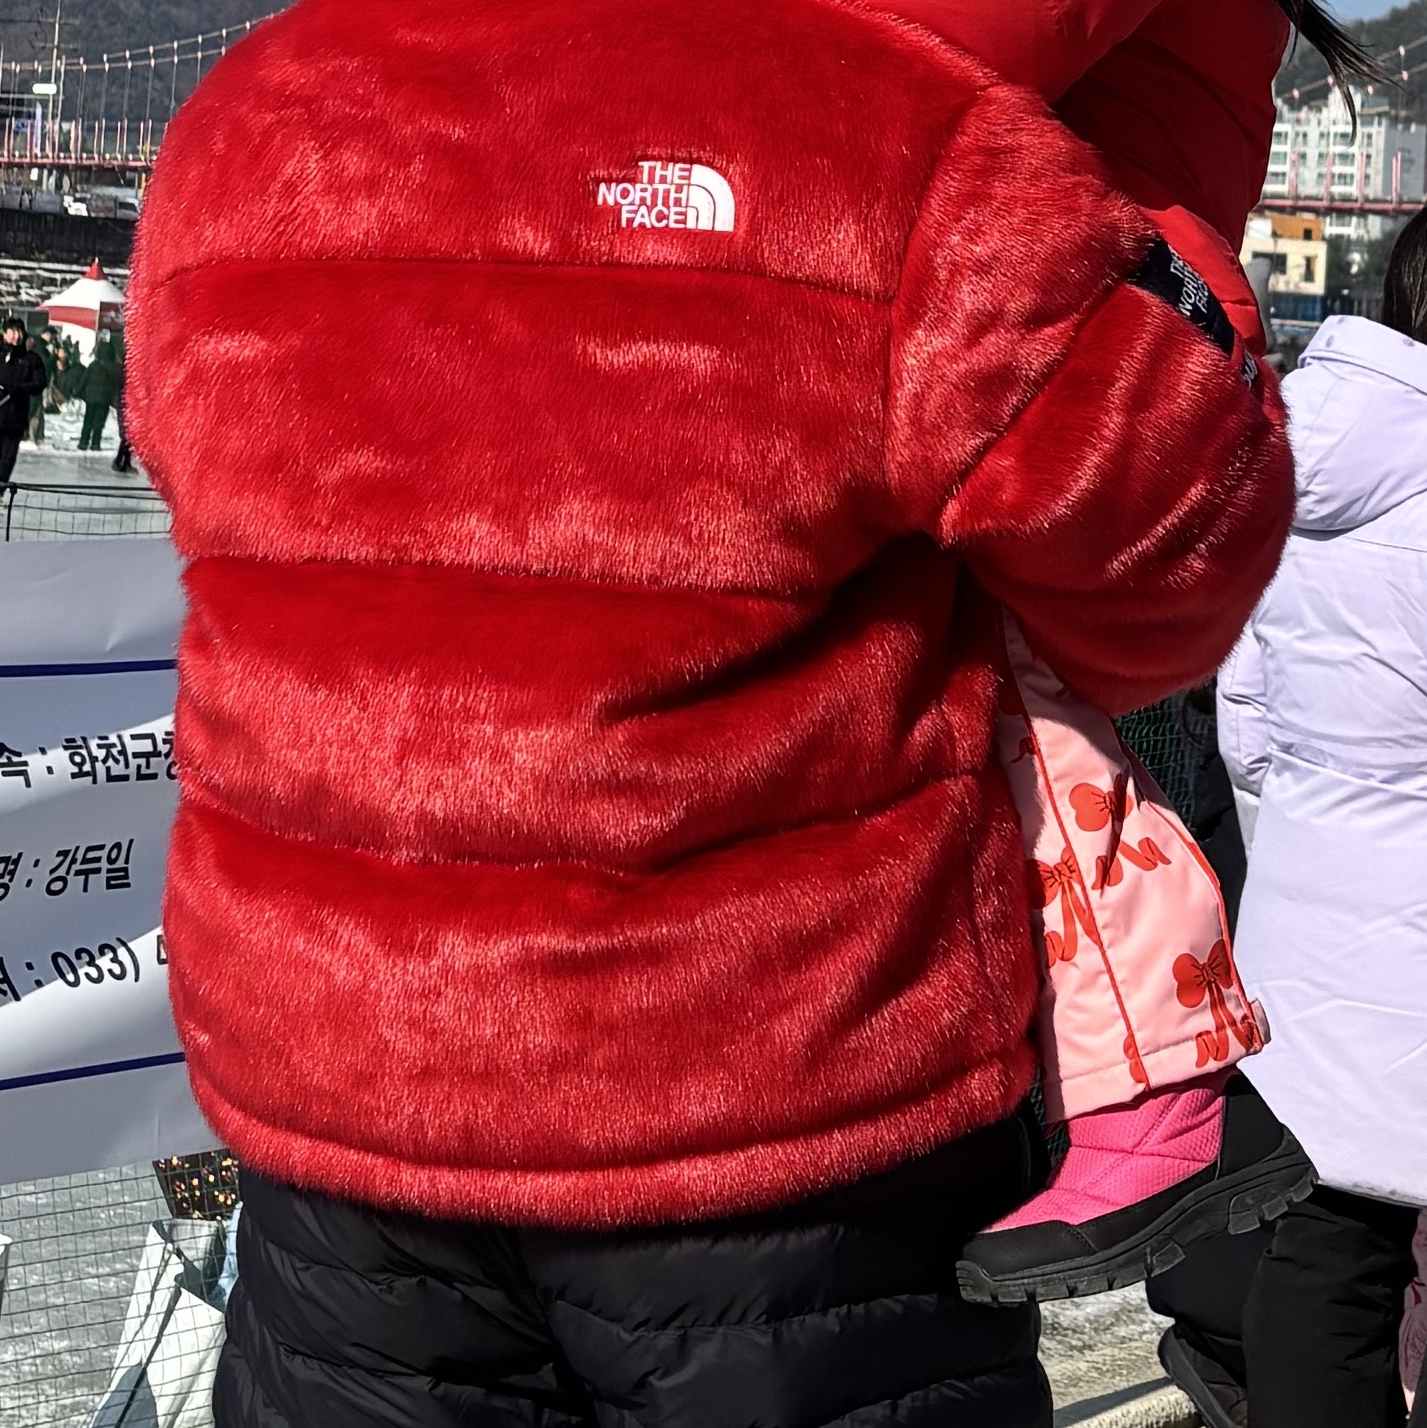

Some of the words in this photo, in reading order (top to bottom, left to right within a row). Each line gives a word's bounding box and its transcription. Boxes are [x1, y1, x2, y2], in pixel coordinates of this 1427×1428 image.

[638, 161, 692, 184] THE
[597, 182, 688, 207] NORTH
[621, 205, 687, 229] FACE
